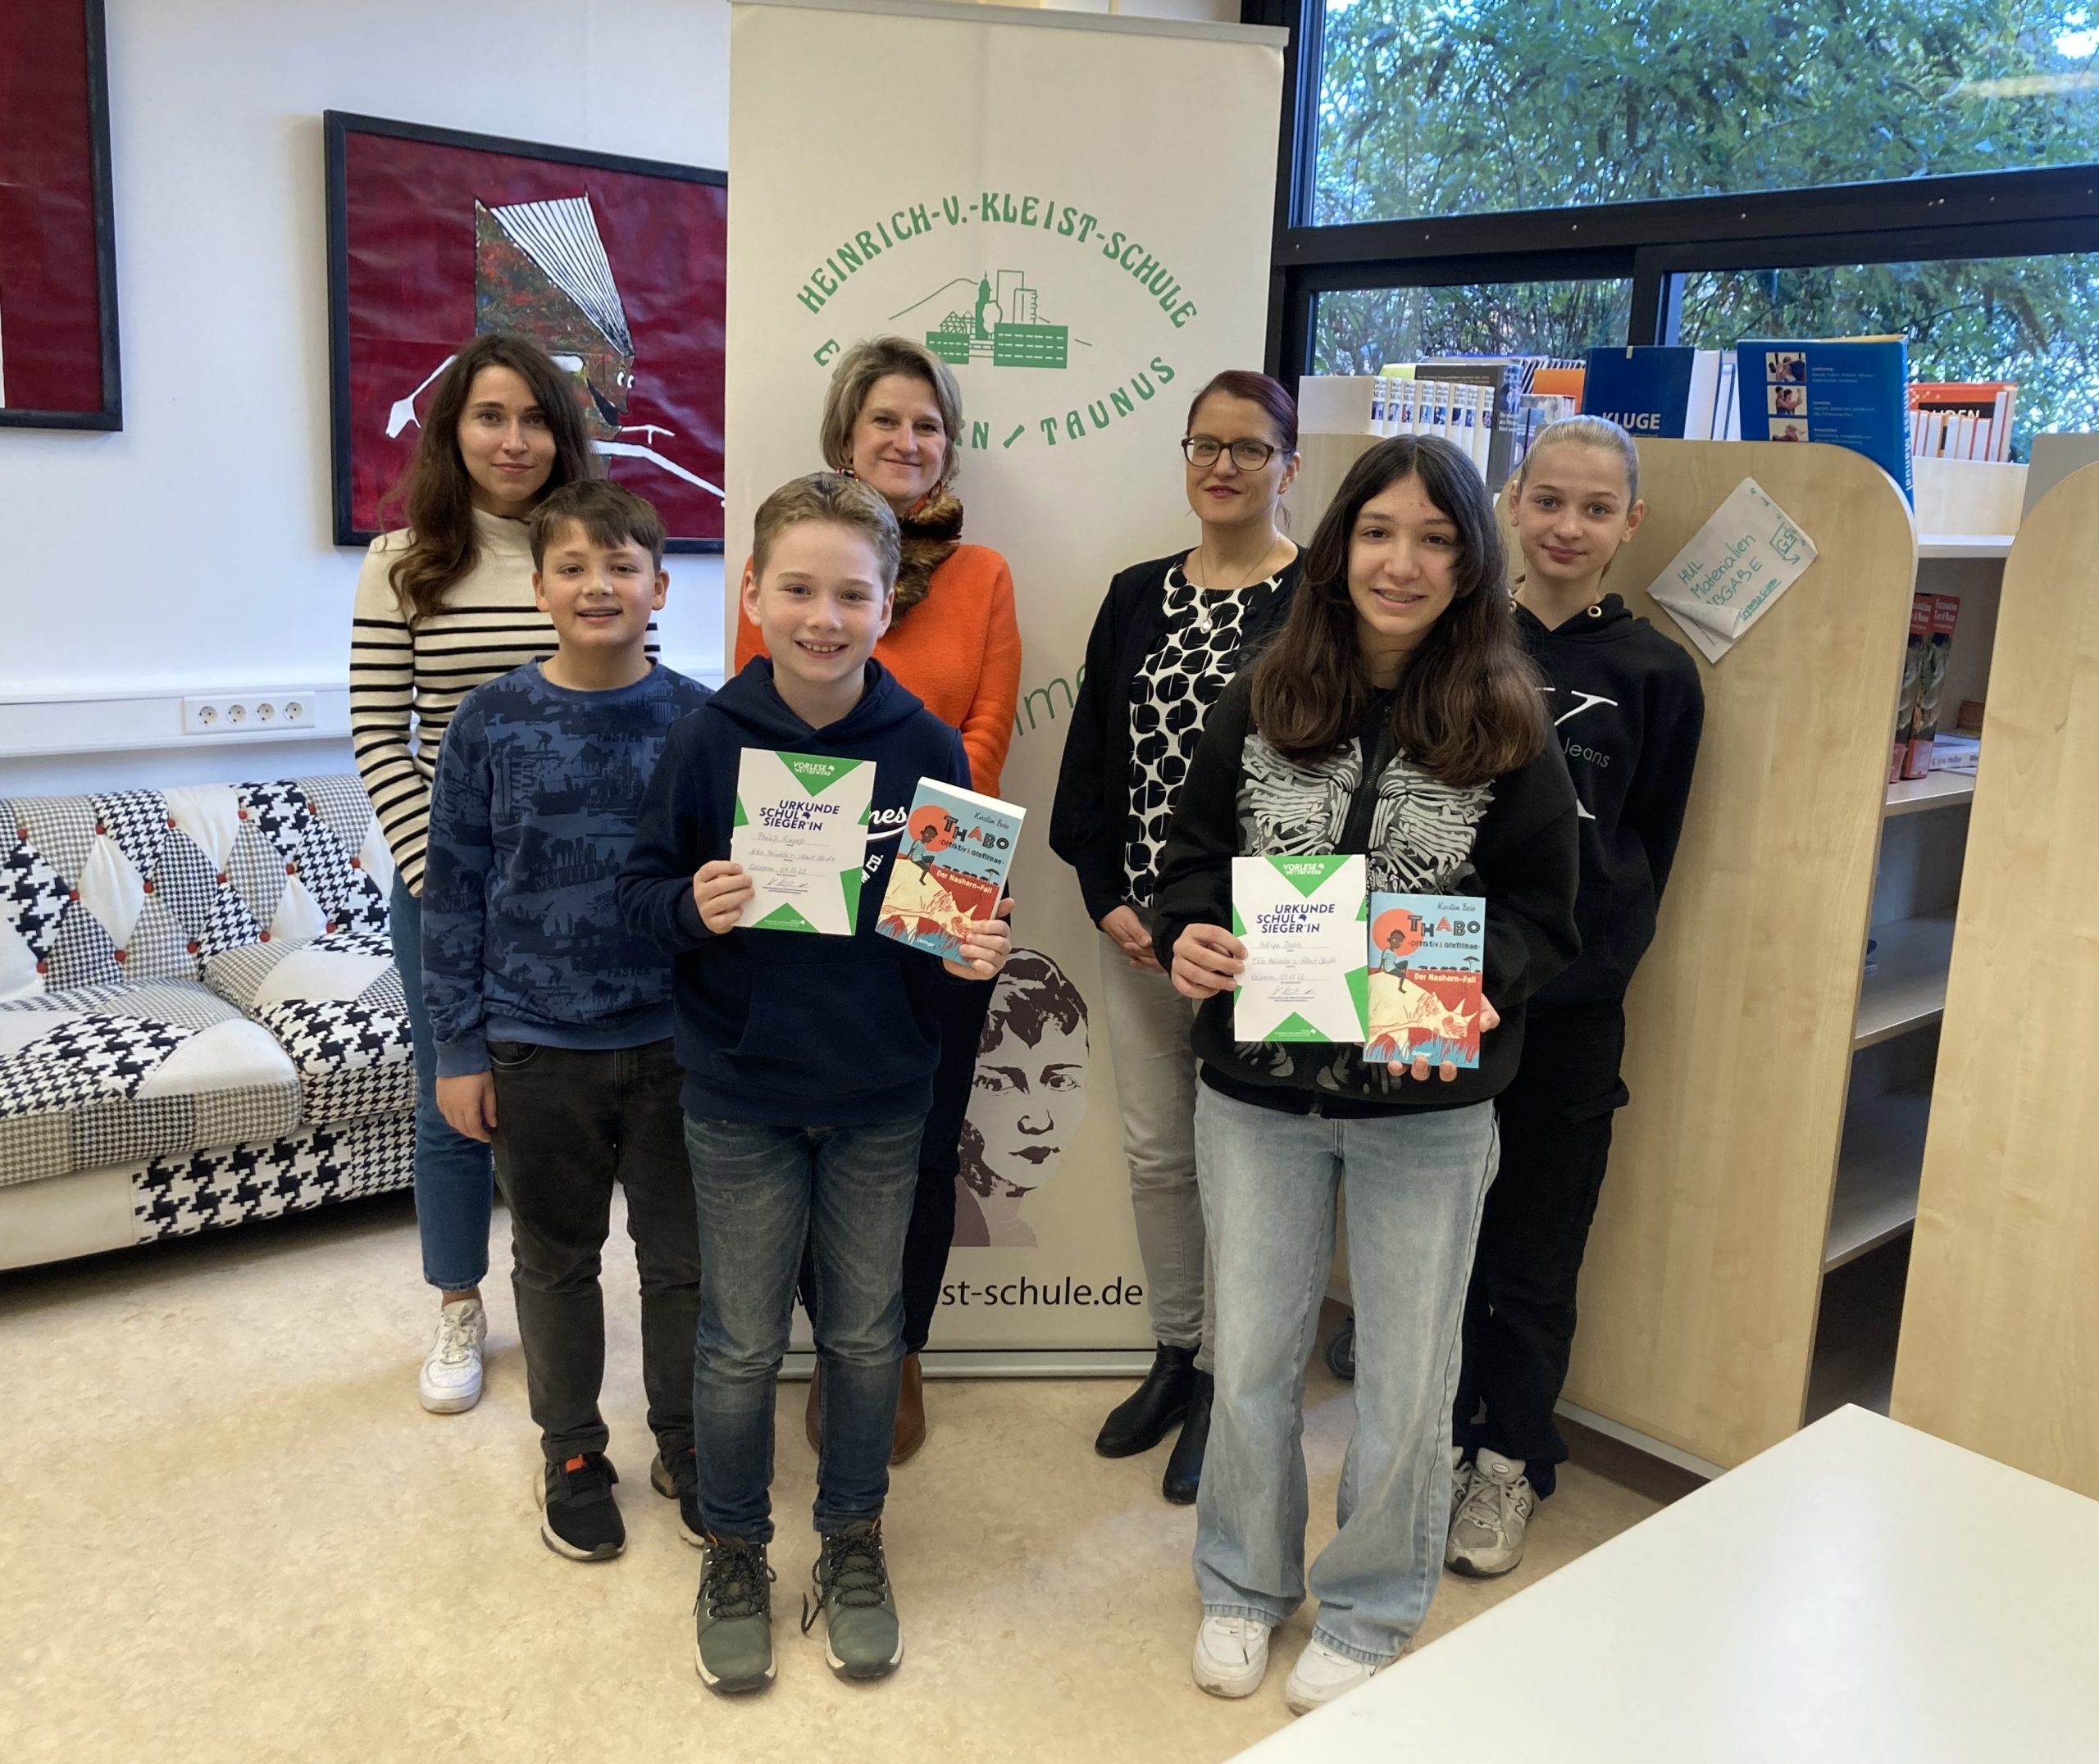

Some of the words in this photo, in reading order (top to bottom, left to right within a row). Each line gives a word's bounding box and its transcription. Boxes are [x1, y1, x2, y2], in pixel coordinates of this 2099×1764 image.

[1040, 356, 1176, 447] TAUNUS
[1904, 438, 1913, 491] Manual
[1706, 556, 1763, 607] BGABE
[1563, 737, 1610, 768] Jeans
[793, 762, 827, 771] VORLESE
[759, 807, 799, 820] SCHUL
[779, 799, 840, 815] URKUNDE
[868, 806, 908, 825] nes
[944, 815, 1009, 850] THABO
[936, 870, 948, 880] Der
[949, 874, 993, 894] Nashorn-Fall
[1256, 914, 1296, 924] SCHUL
[1274, 903, 1336, 914] URKUNDE
[1407, 915, 1481, 938] THABO
[1414, 972, 1427, 980] Der
[1428, 973, 1477, 984] Nashorn-Fall
[936, 1276, 1144, 1306] st-schule.de
